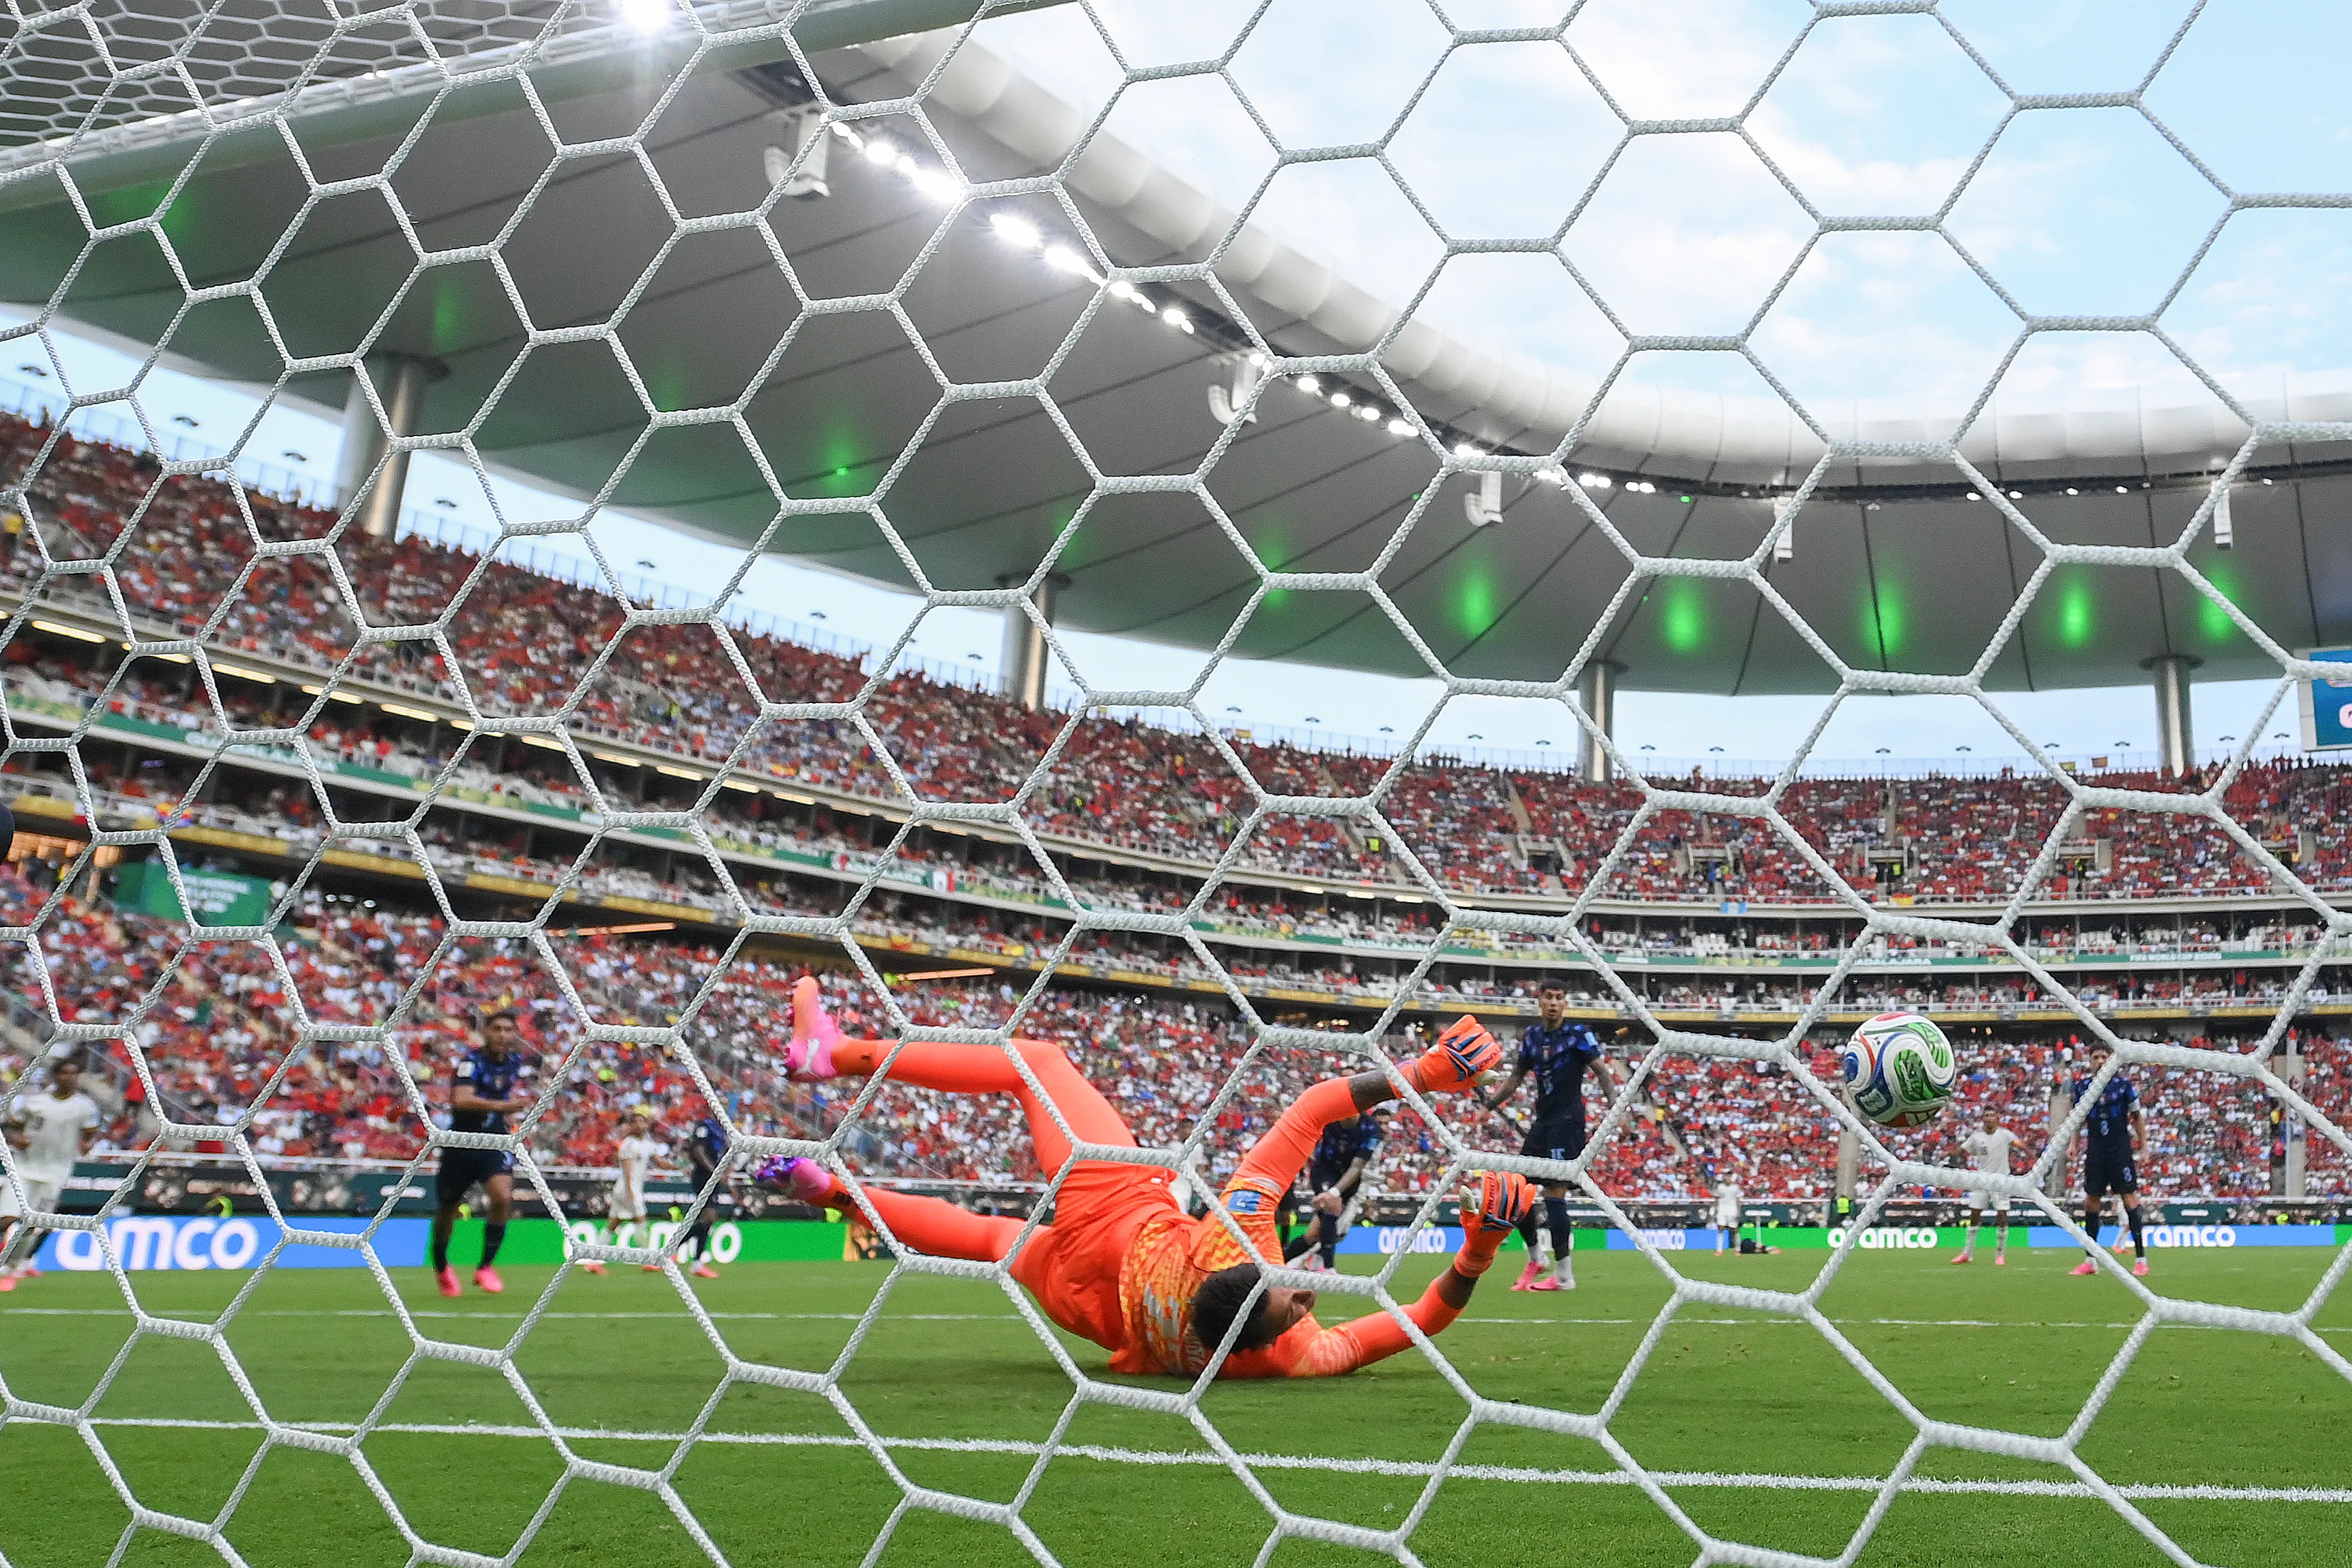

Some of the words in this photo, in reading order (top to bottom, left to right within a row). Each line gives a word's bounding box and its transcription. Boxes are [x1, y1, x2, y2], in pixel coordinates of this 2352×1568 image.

[2123, 1167, 2133, 1182] 8
[54, 1217, 259, 1270] amco
[1634, 1229, 1686, 1250] amco
[1827, 1227, 1938, 1249] aamco
